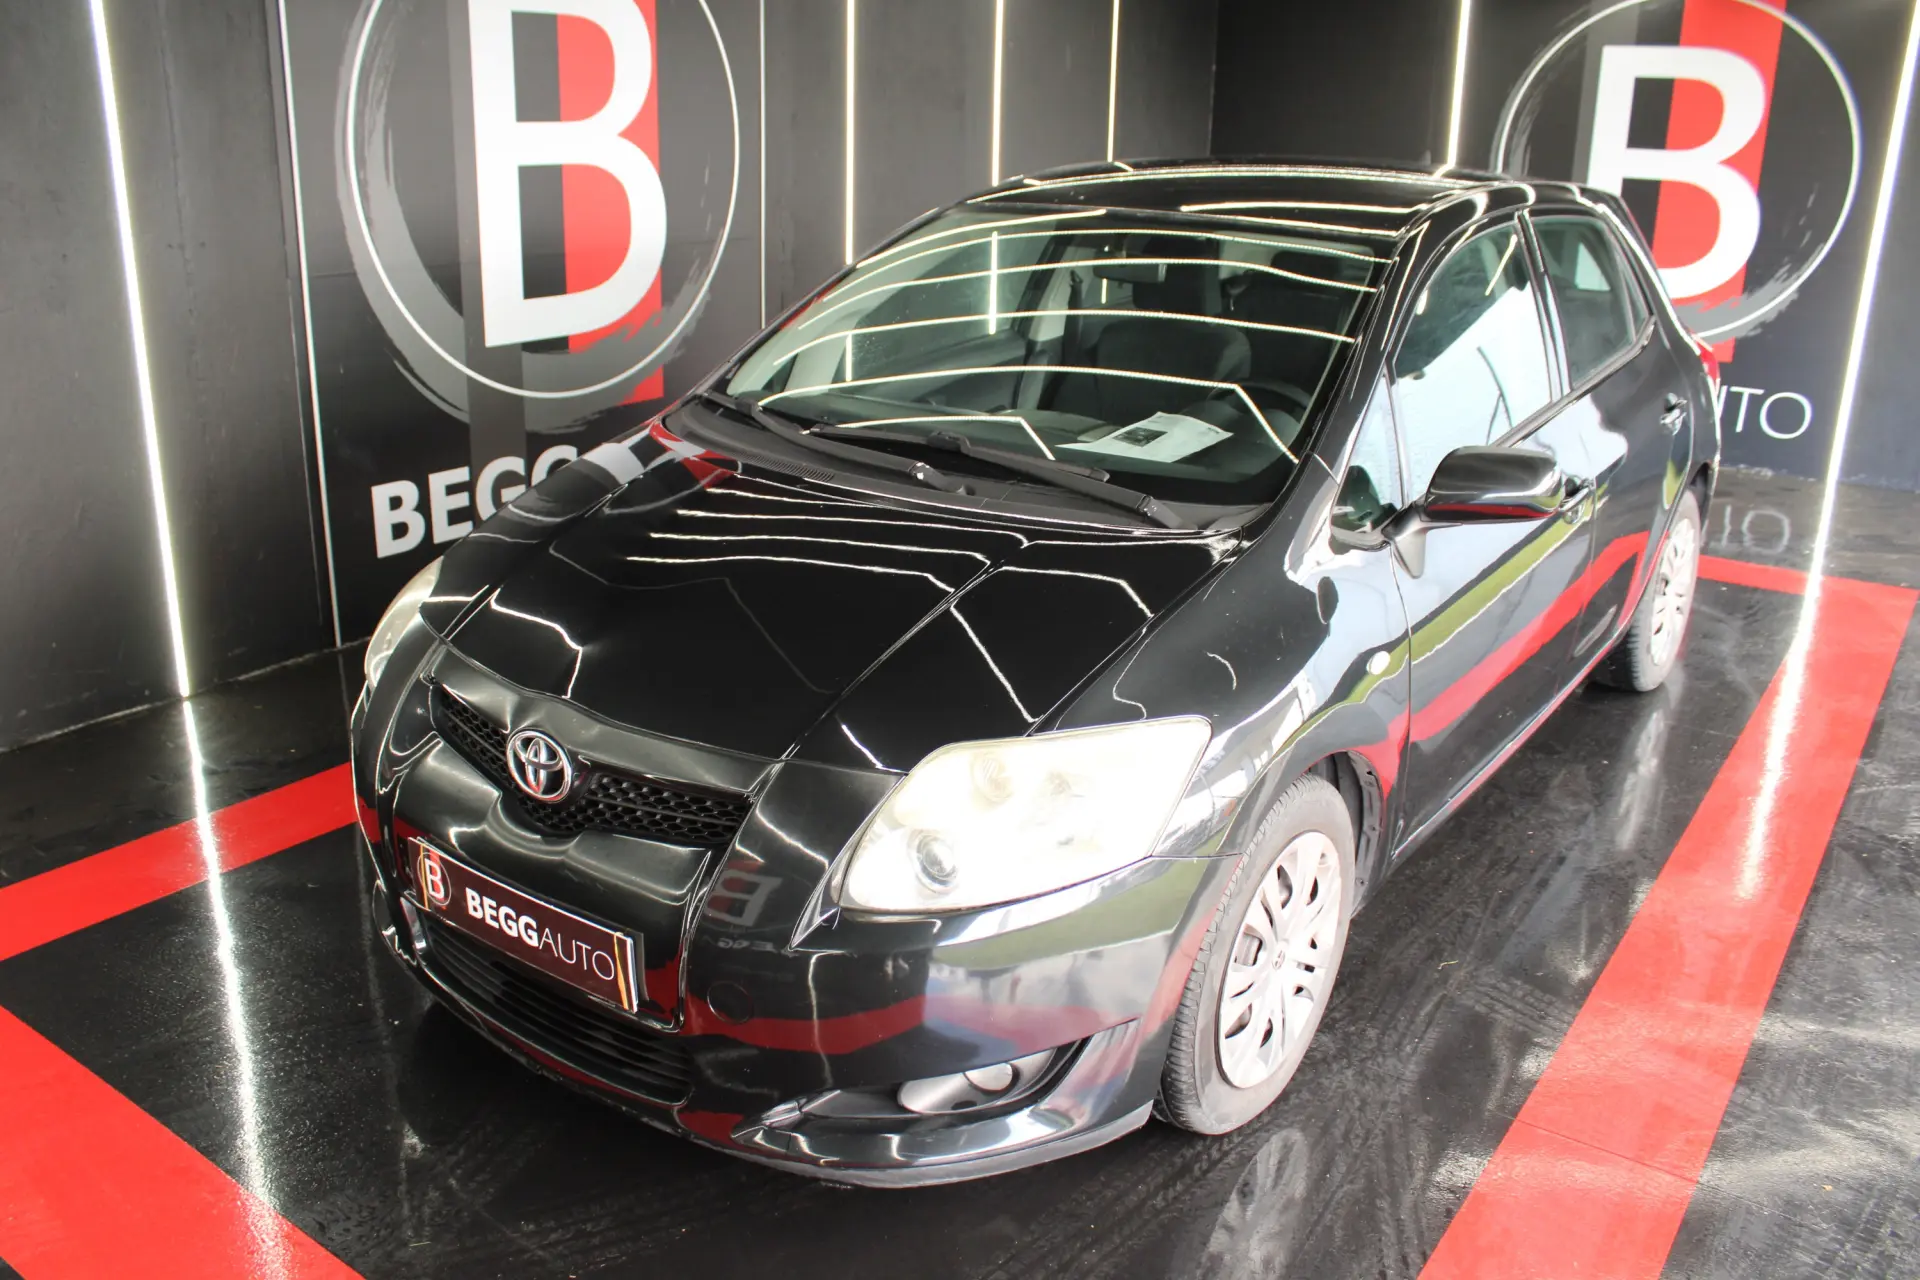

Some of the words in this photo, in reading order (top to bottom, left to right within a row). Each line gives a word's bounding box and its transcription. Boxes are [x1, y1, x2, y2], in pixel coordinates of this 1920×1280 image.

[467, 0, 667, 348] B
[1587, 44, 1765, 300] B
[424, 858, 445, 900] B
[465, 887, 615, 981] BEGGAUTO
